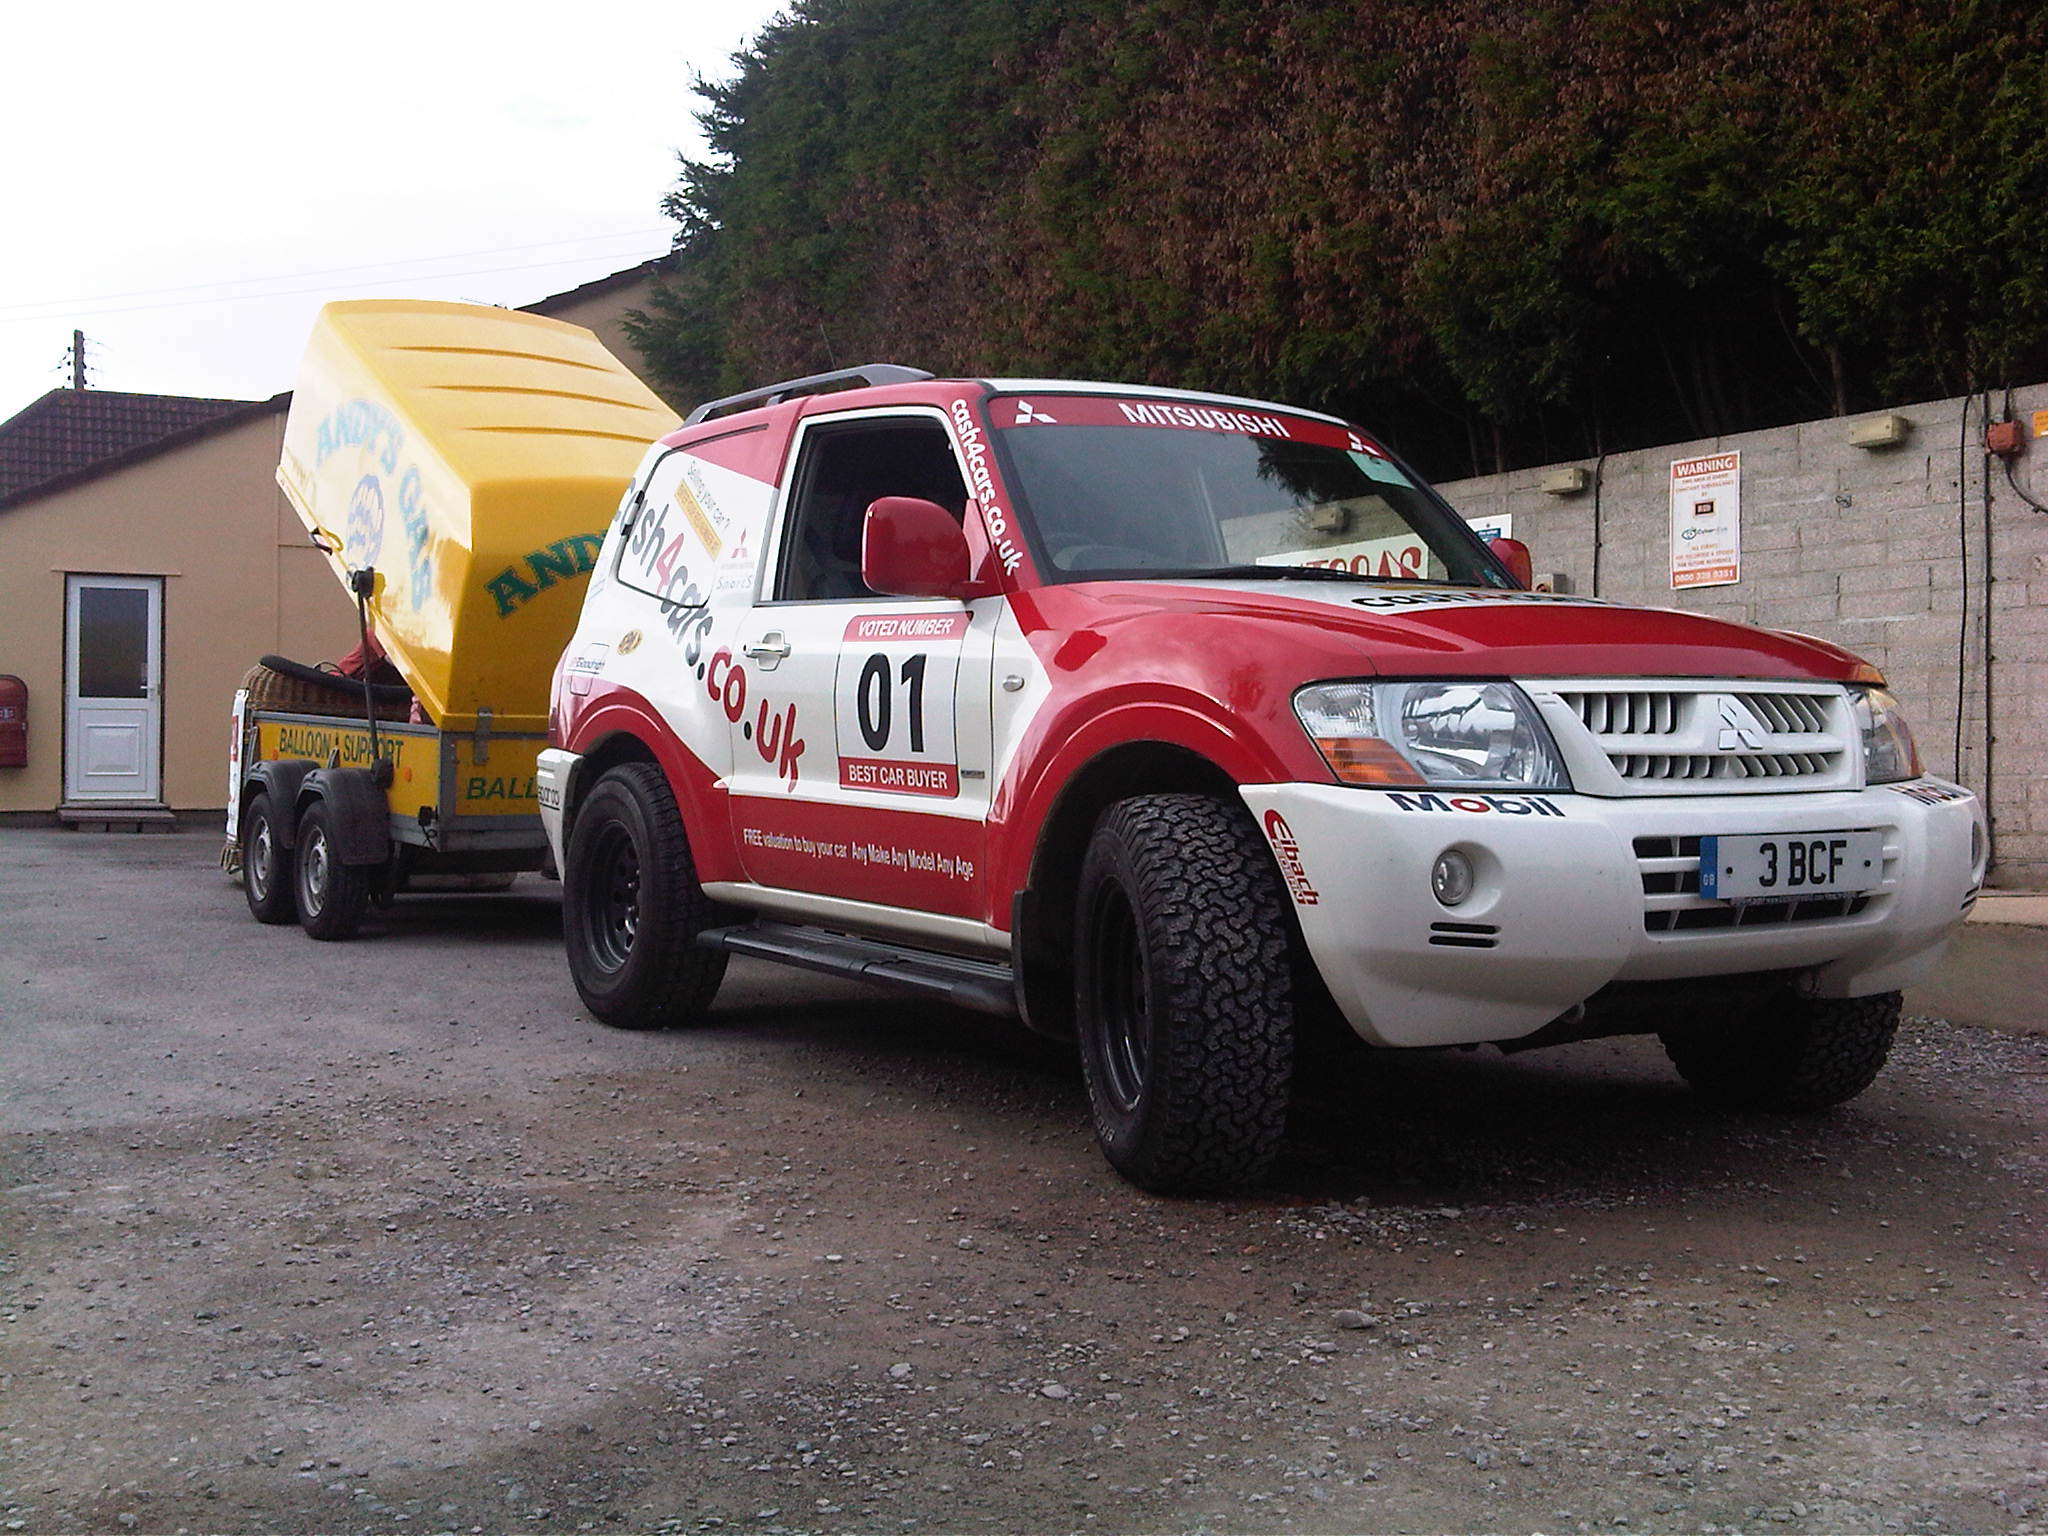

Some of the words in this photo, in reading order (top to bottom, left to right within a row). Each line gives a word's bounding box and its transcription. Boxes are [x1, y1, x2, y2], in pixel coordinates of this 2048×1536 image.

[1118, 403, 1291, 438] MITSUBISHI
[1677, 457, 1733, 476] WARNING
[951, 399, 1023, 576] cash4cars.co.uk
[483, 529, 607, 620] AND
[858, 620, 899, 637] VOTED
[898, 618, 955, 636] NUMBER
[857, 652, 928, 753] 01
[280, 728, 332, 759] BALLOON
[848, 764, 878, 784] BEST
[880, 766, 905, 785] CAR
[906, 769, 949, 791] BUYER
[1386, 793, 1566, 817] Mobil
[743, 827, 763, 847] FREE
[763, 832, 794, 851] valuation
[794, 835, 802, 852] to
[802, 836, 817, 858] buy
[816, 842, 833, 859] your
[834, 844, 848, 858] car
[852, 841, 868, 866] Any
[867, 843, 891, 865] Make
[891, 846, 908, 872] Any
[908, 849, 936, 871] Model
[937, 852, 954, 879] Any
[956, 856, 974, 882] Age
[1264, 809, 1320, 905] Eibach
[1759, 842, 1778, 888] 3
[1788, 840, 1848, 887] BCF
[1703, 874, 1715, 886] GB
